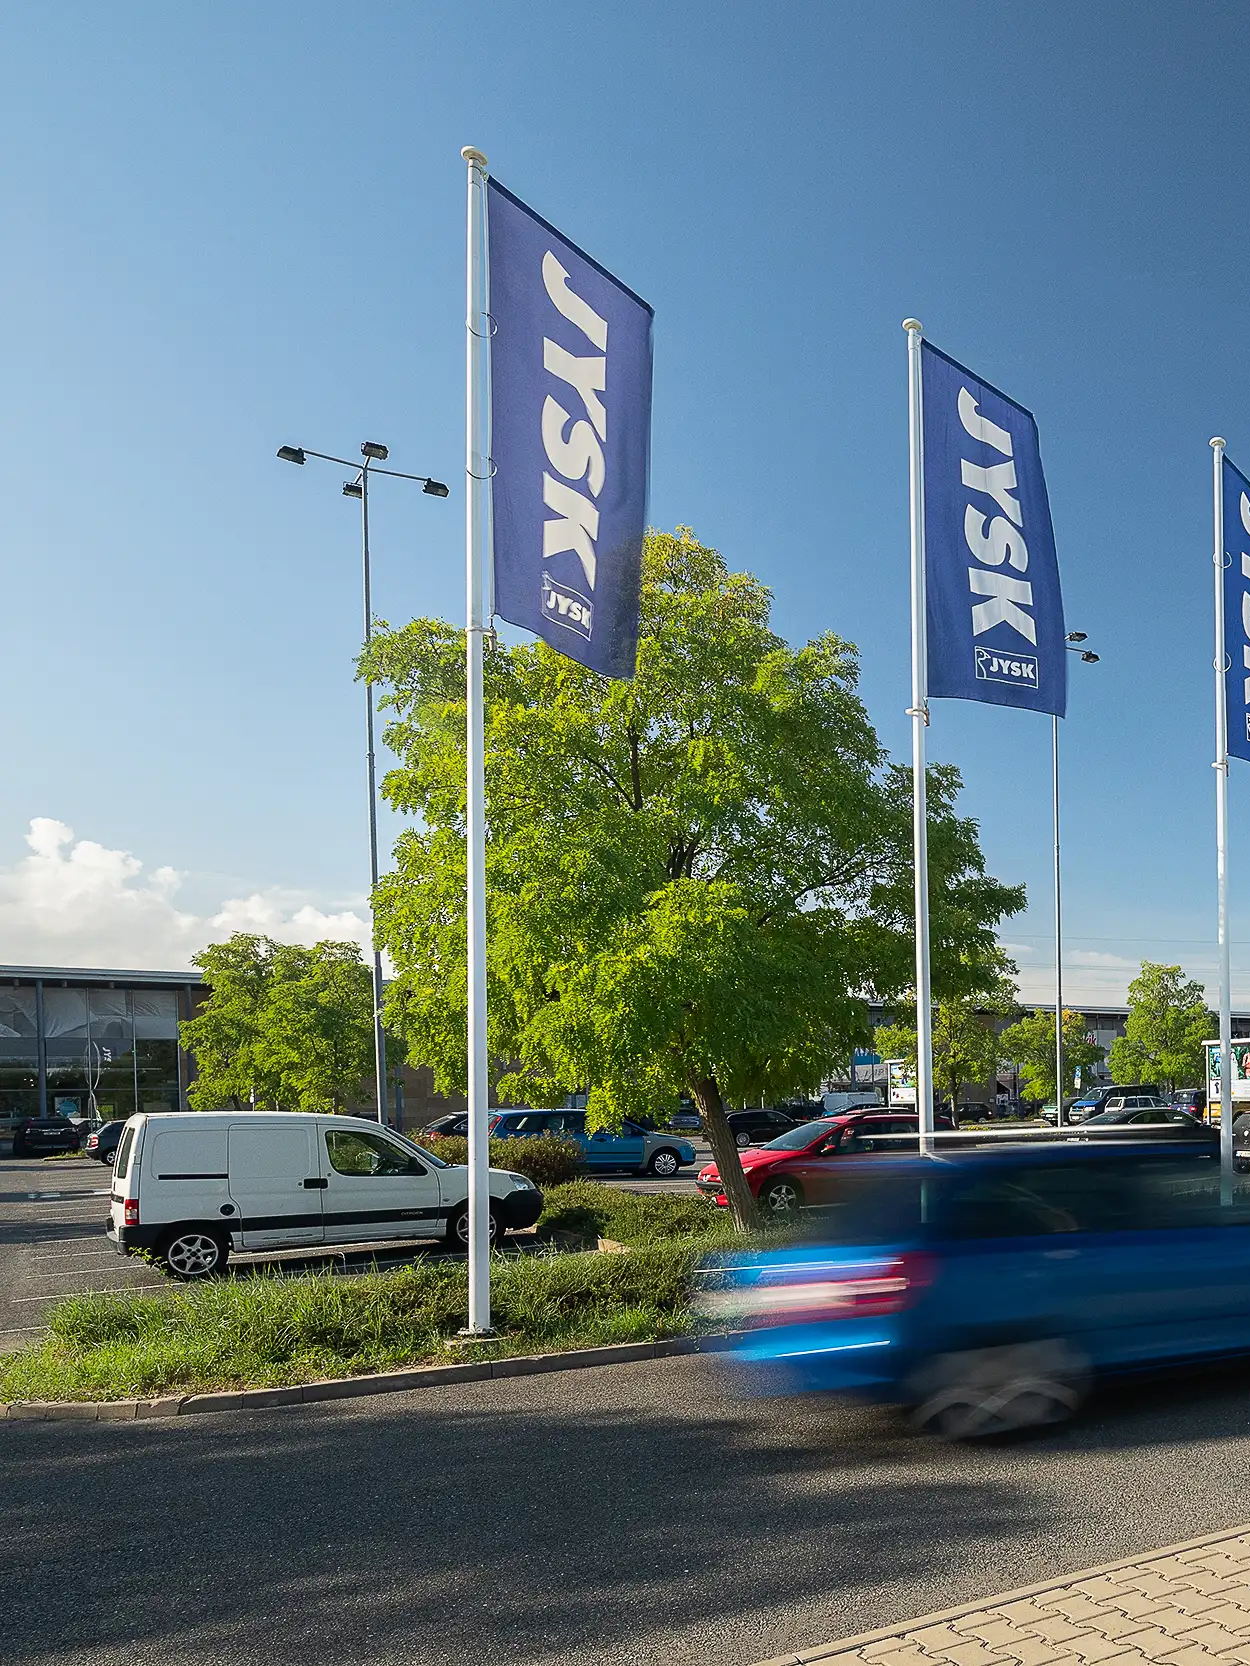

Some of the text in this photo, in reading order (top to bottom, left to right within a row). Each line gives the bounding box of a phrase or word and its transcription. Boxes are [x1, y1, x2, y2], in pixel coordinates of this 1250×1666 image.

[541, 249, 608, 592] JYSK
[957, 386, 1037, 647] JYSK
[546, 590, 592, 630] JYSK
[990, 657, 1036, 680] JYSK
